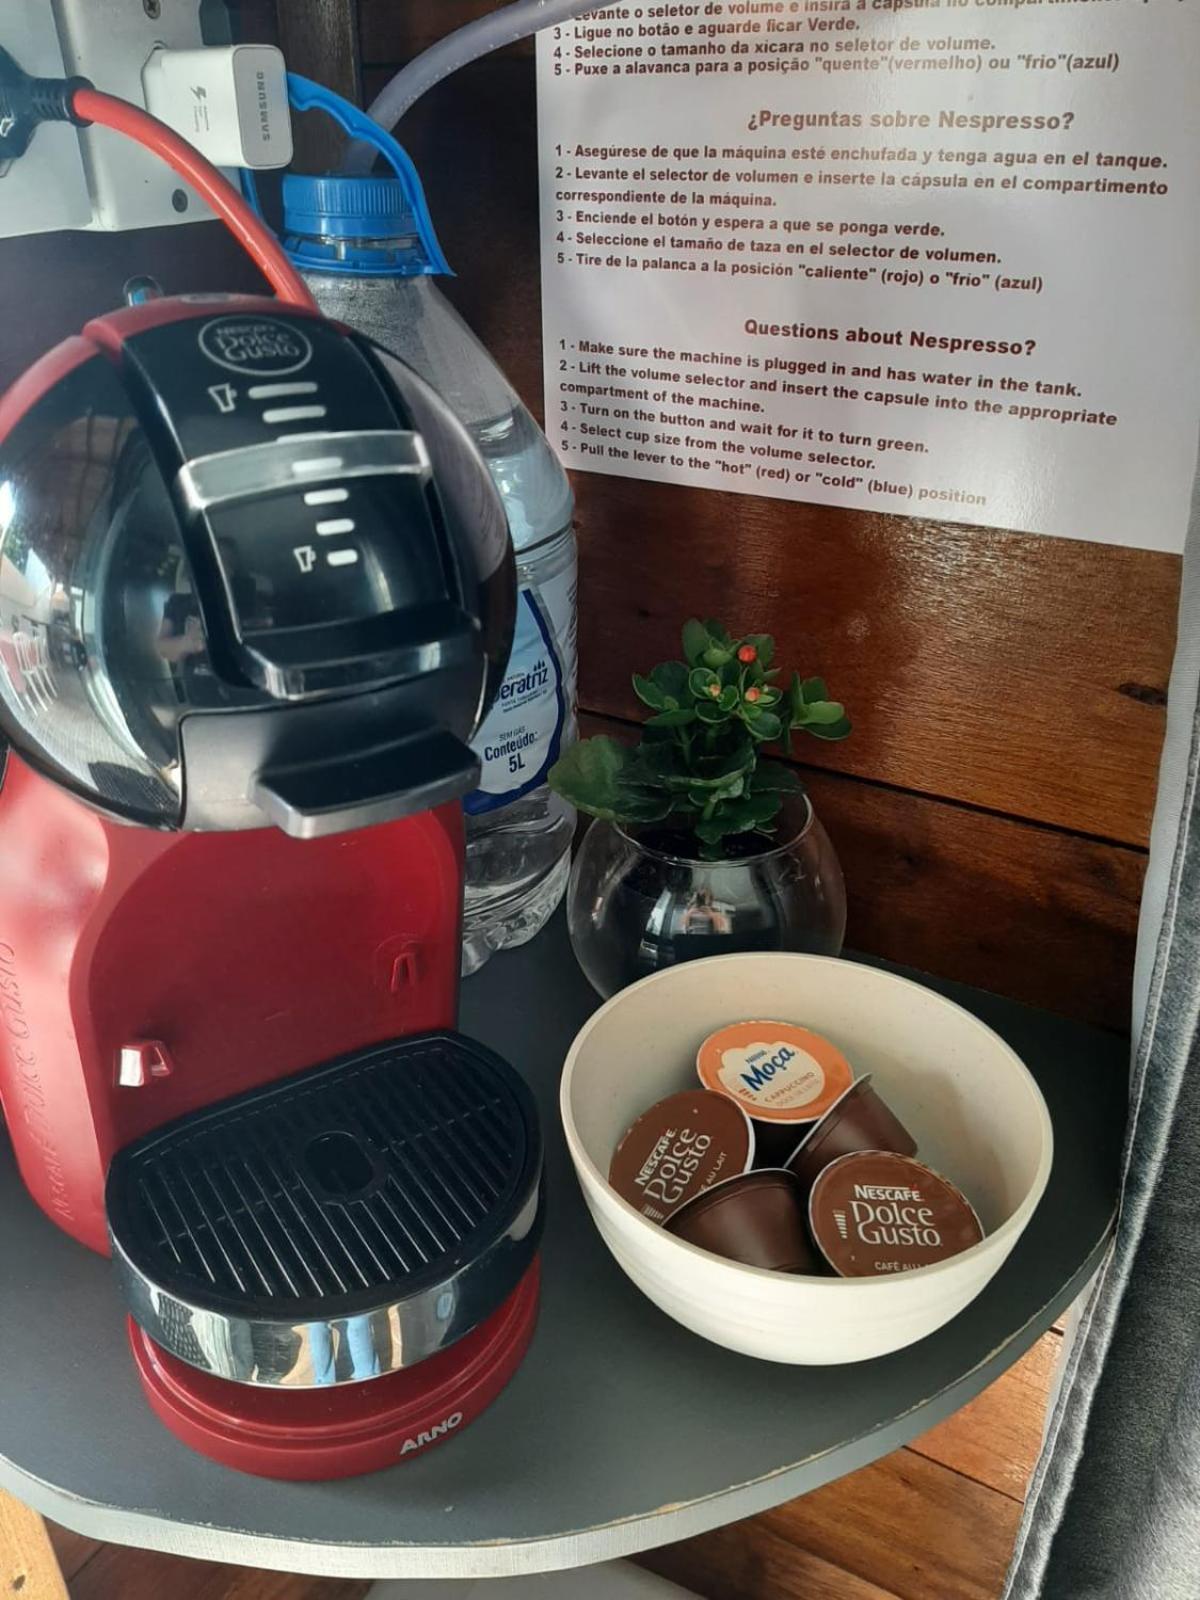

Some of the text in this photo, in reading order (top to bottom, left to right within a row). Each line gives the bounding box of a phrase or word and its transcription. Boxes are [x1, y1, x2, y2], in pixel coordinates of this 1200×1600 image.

[574, 6, 630, 21] evante
[647, 4, 700, 18] seletor
[703, 1, 723, 16] de
[727, 0, 785, 14] volume
[574, 16, 860, 42] Ligue no botão aguarde ficar Verde.
[574, 36, 996, 59] Selecione tamanho da no seletor de volume.
[574, 57, 1011, 76] Puxe alavanca para posição ou
[255, 71, 271, 142] SAMSUNG
[747, 109, 1075, 133] ¿Preguntas sobre Nespresso?
[574, 144, 1168, 171] Asegúrese de que máquina esté enchufada tenga agua tanque.
[575, 166, 1169, 195] Levante selector de volumen inserte cápsula compartimento
[555, 190, 777, 209] correspondiente de máquina.
[575, 210, 945, 237] Enciende botón espera que se ponga verde.
[576, 231, 1002, 264] Seleccione tamaño de taza selector de volumen.
[575, 252, 602, 266] Tire
[605, 254, 622, 267] de
[642, 257, 697, 271] palanca
[798, 263, 877, 281] "caliente"
[881, 268, 924, 287] (rojo)
[994, 274, 1043, 294] (azul)
[744, 319, 1037, 356] Questions about Nespresso?
[578, 340, 1082, 397] Make sure the machine is plugged in and has water in the tank.
[559, 382, 765, 413] compartment of the machine.
[579, 361, 1118, 426] Lift the volume selector and insert the capsule into the appropriate
[579, 402, 929, 454] Turn on the button and wait for it to turn green.
[580, 422, 876, 470] Select cup size from the volume selector.
[580, 442, 987, 506] Pull the lever to the "hot" (red) or "cold" (blue) position
[496, 667, 549, 701] eratriz
[508, 753, 526, 773] 5L
[740, 1046, 796, 1092] Moça
[642, 1128, 699, 1200] Dolce
[661, 1134, 713, 1204] Gusto
[848, 1200, 937, 1227] Dolce
[857, 1223, 943, 1247] Gusto
[400, 1411, 464, 1456] ARNO
